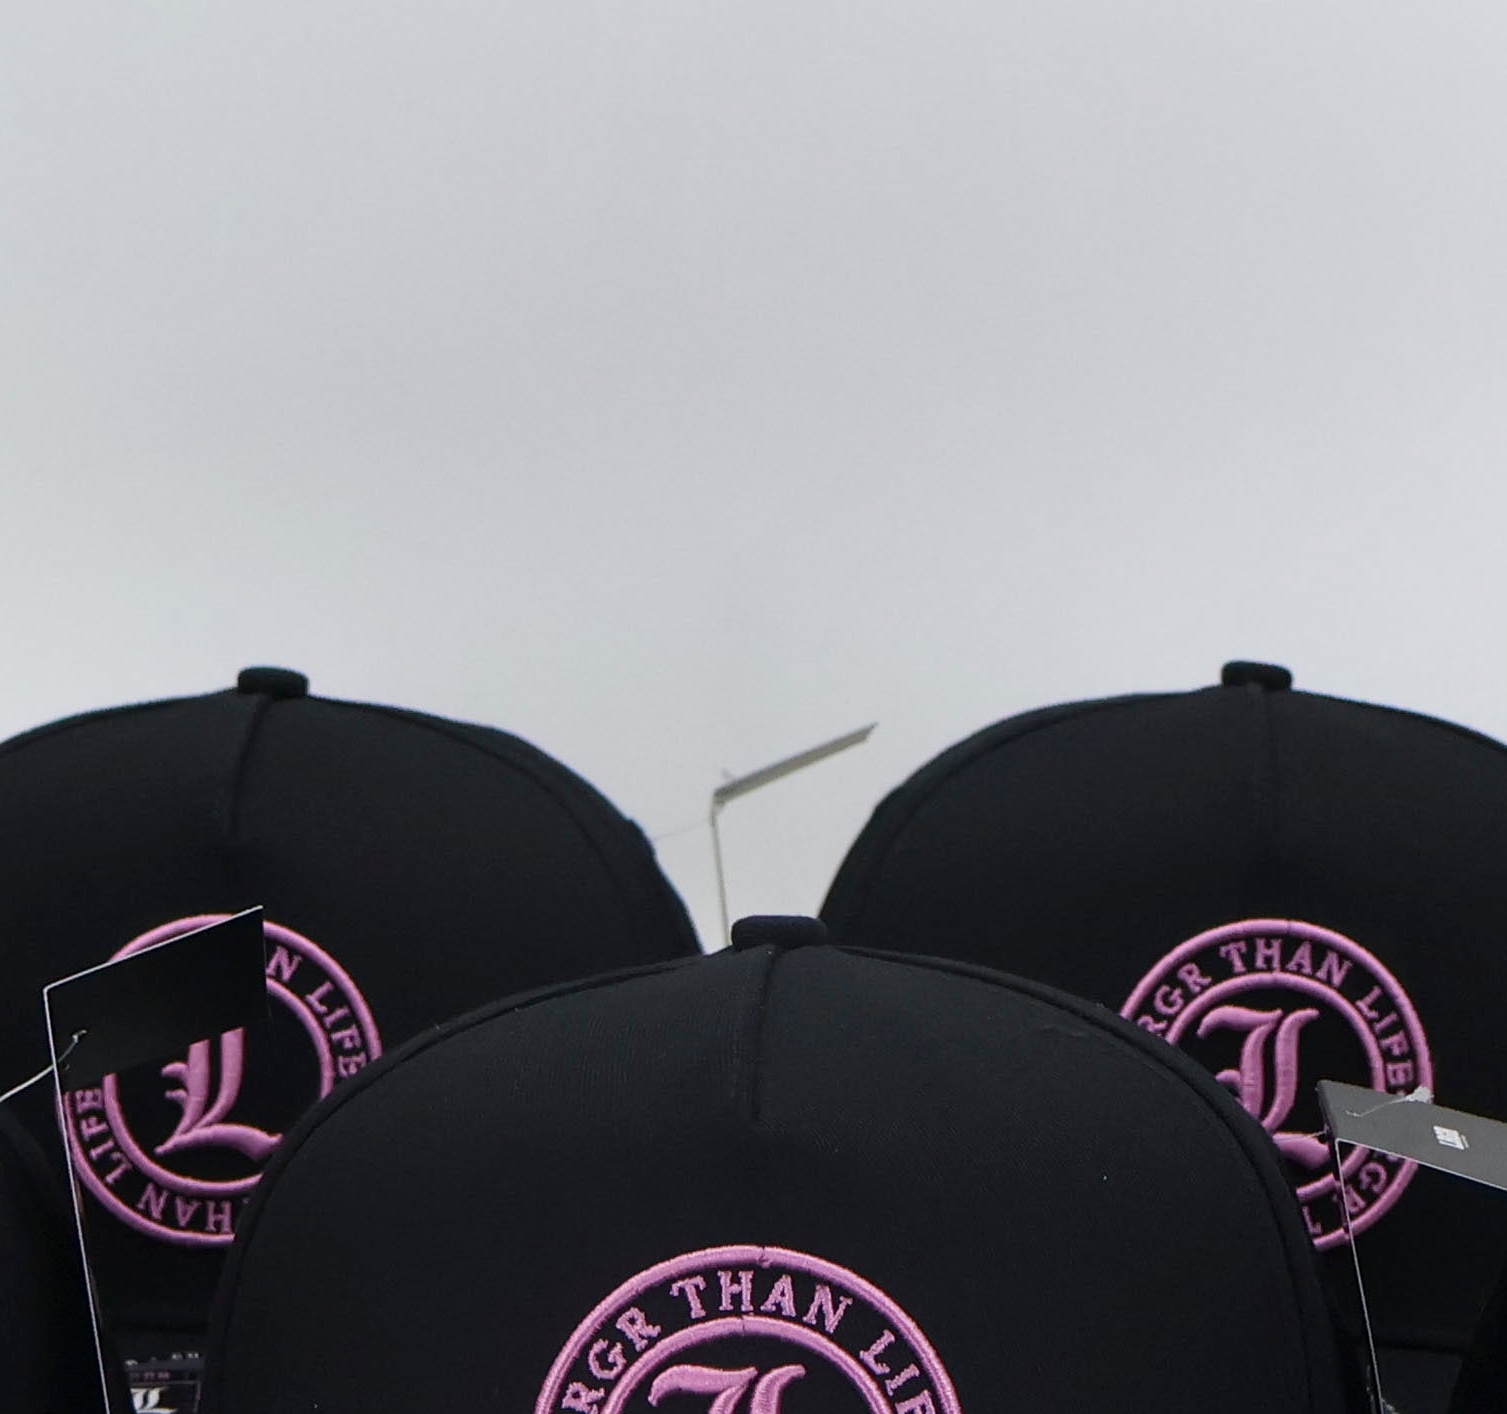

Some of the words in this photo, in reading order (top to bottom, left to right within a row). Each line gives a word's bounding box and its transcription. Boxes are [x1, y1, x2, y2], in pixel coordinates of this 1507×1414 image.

[305, 981, 367, 1078] LIFE
[1138, 962, 1212, 1038] RGR
[1219, 938, 1353, 988] THAN
[1355, 985, 1415, 1085] LIFE
[1197, 1005, 1332, 1170] L
[75, 1088, 133, 1184] LIFE
[138, 1182, 234, 1233] HAN
[670, 1270, 852, 1334] THAN
